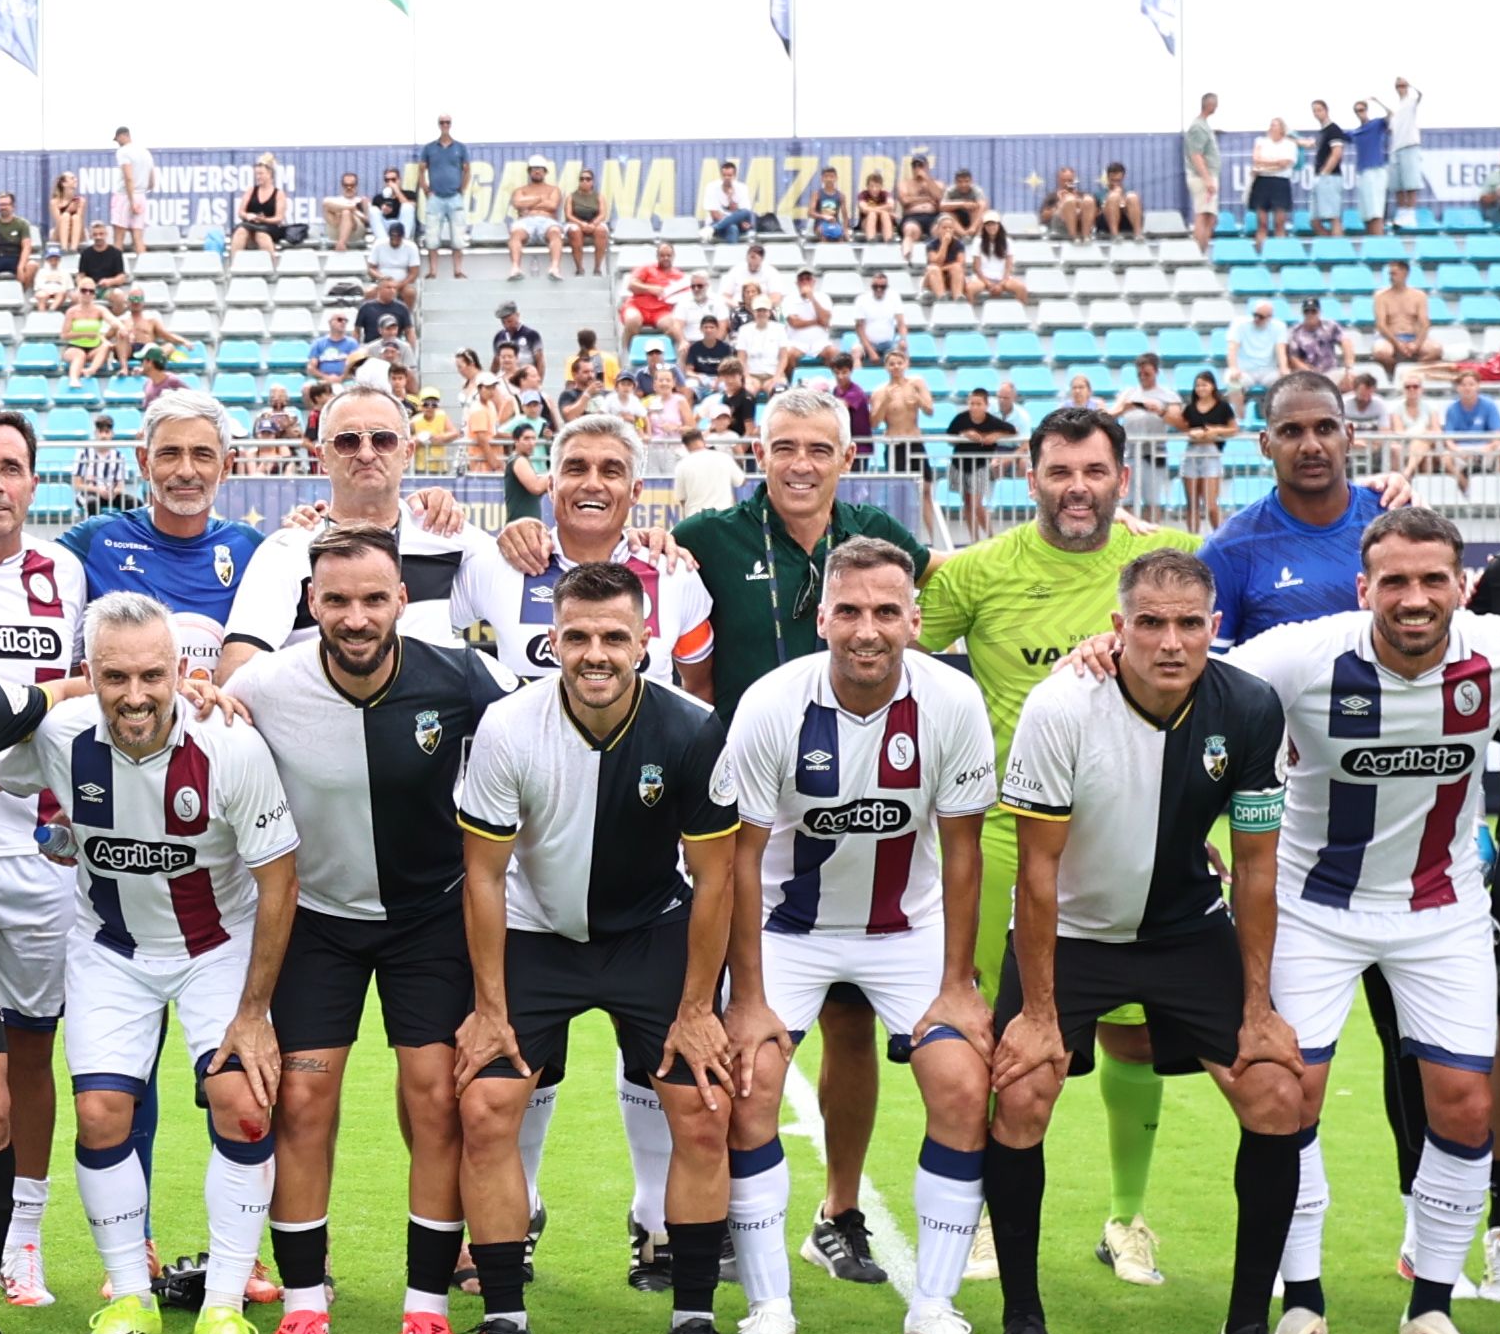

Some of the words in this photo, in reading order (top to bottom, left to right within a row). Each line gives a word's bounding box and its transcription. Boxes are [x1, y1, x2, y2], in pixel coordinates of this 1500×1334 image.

[195, 198, 228, 225] AS
[1353, 749, 1465, 774] Agriloja
[1234, 802, 1284, 824] CAPITÃO
[93, 844, 188, 871] Agriloja
